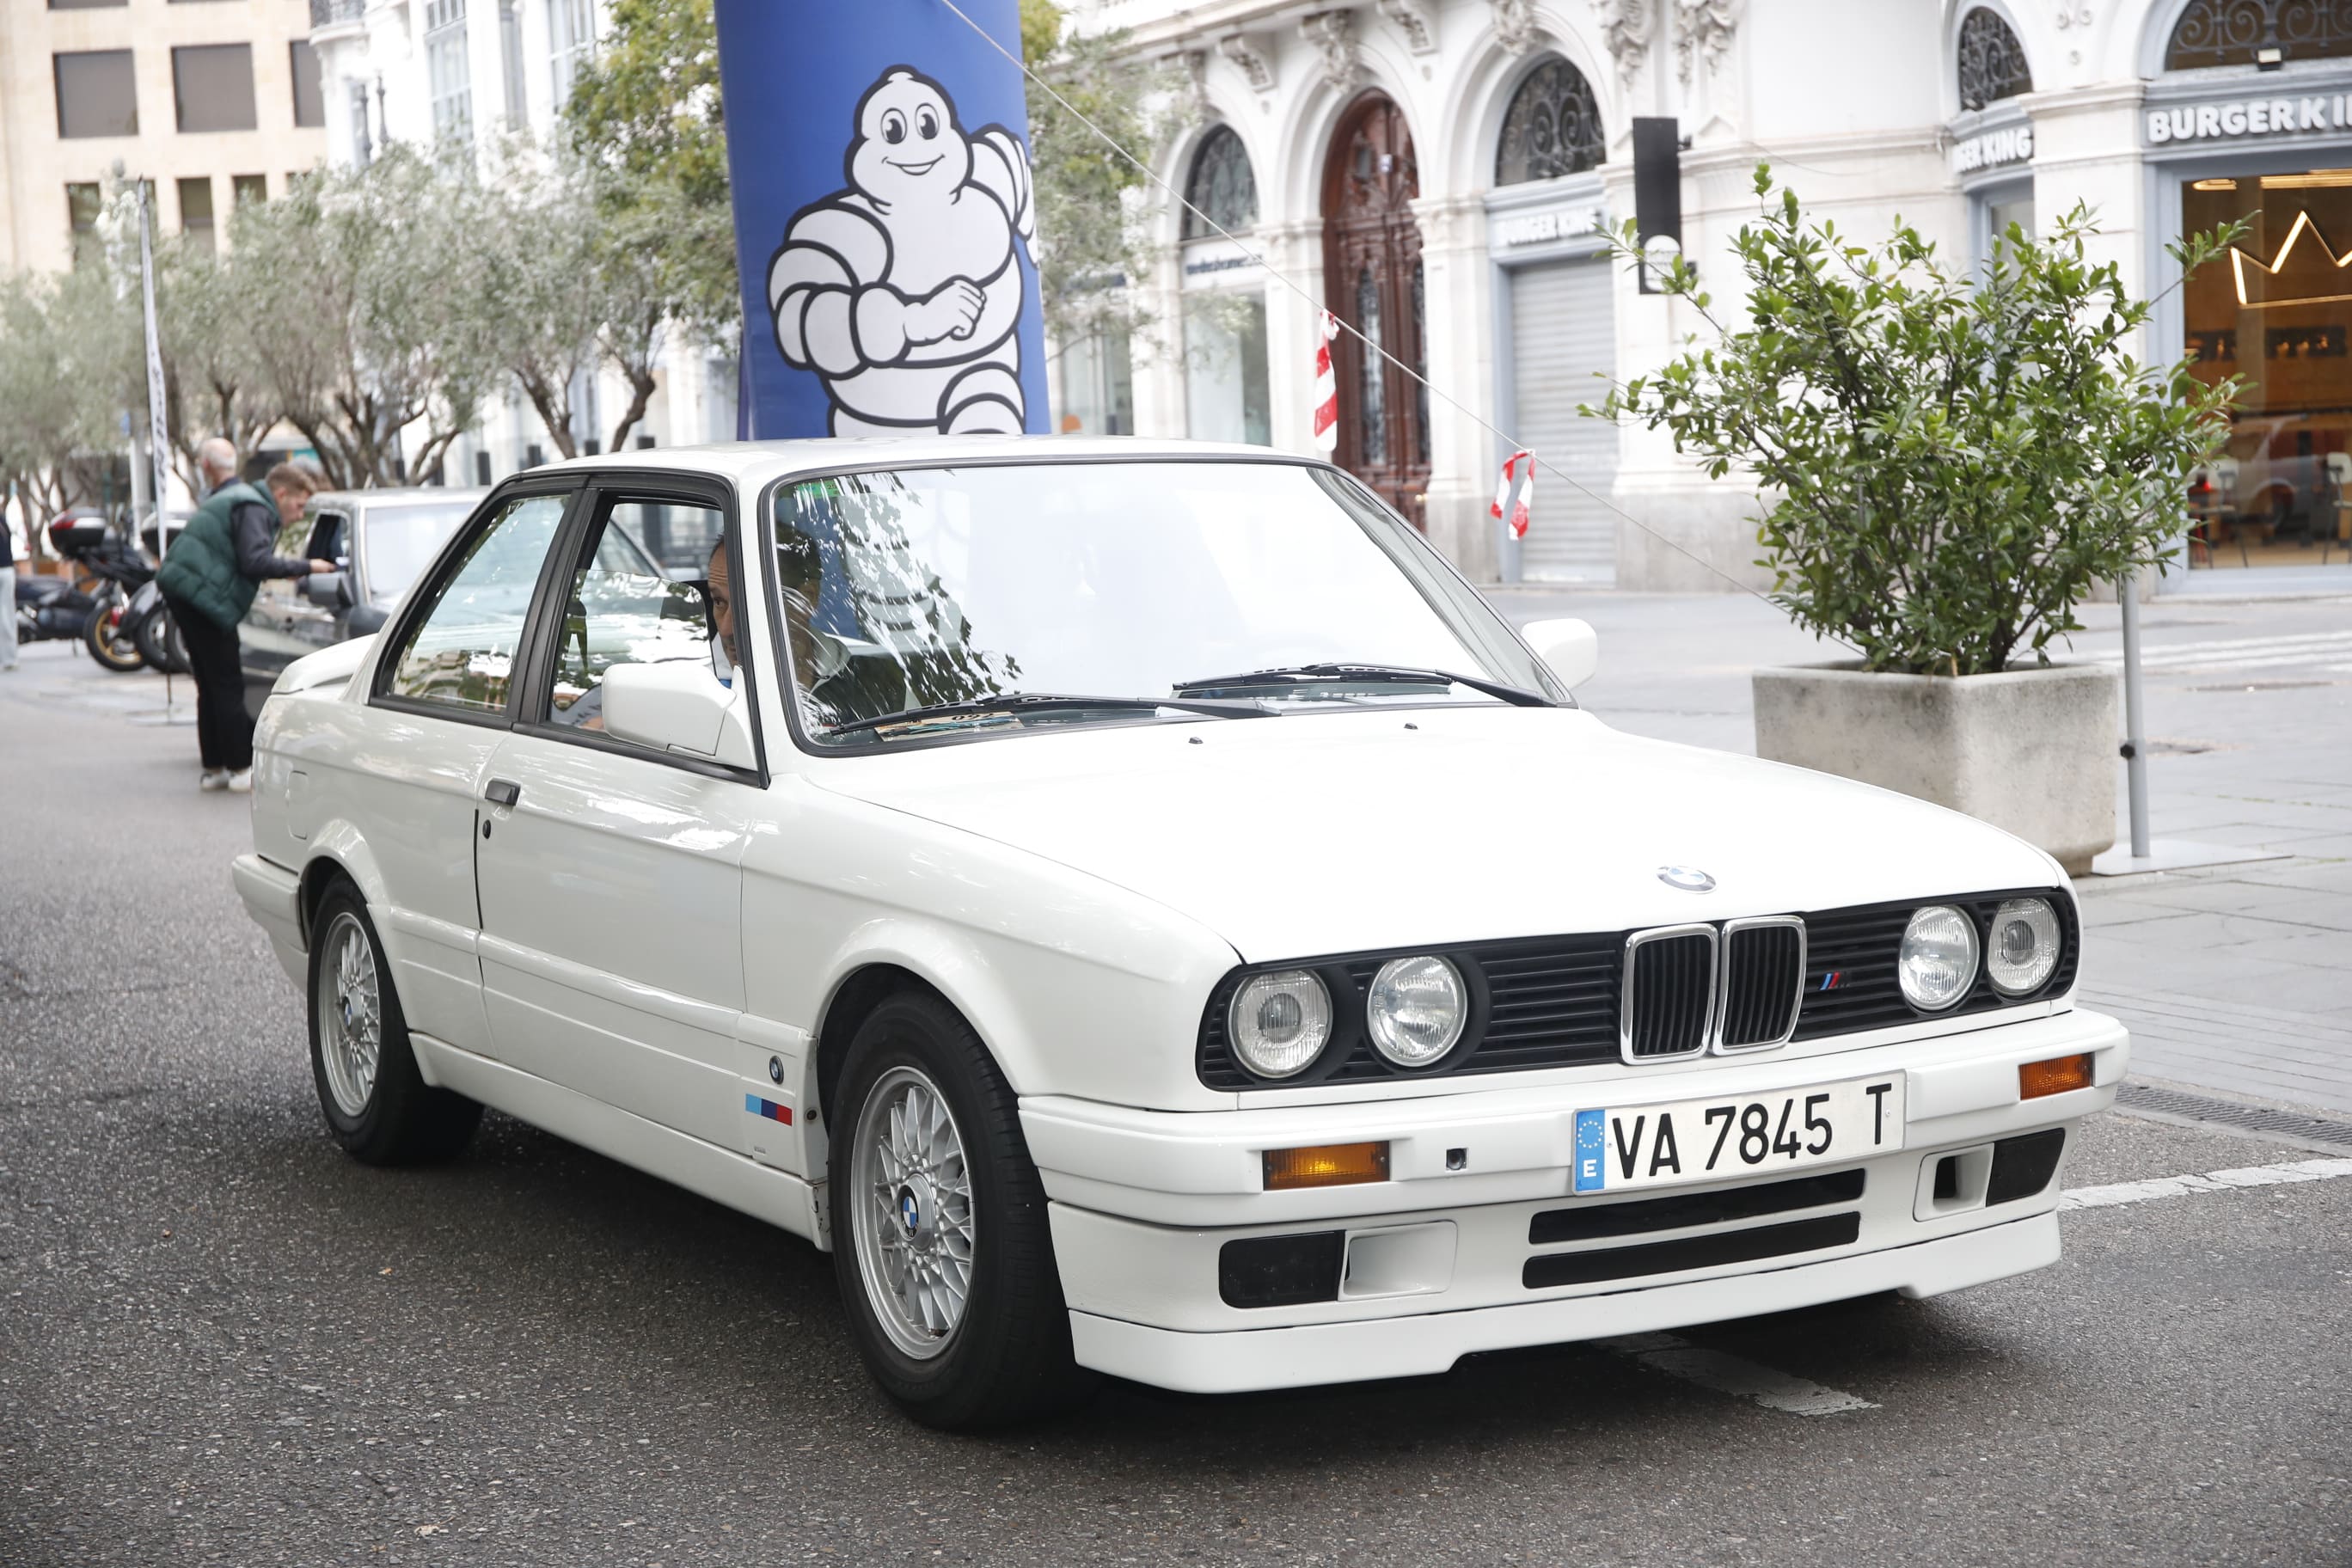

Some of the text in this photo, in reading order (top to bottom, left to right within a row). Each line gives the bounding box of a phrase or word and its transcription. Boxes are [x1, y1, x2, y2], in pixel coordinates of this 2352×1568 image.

[2148, 100, 2295, 143] BURGER
[1982, 127, 2031, 164] KING
[1613, 1083, 1893, 1179] VA 7845 T
[1583, 1159, 1597, 1179] E
